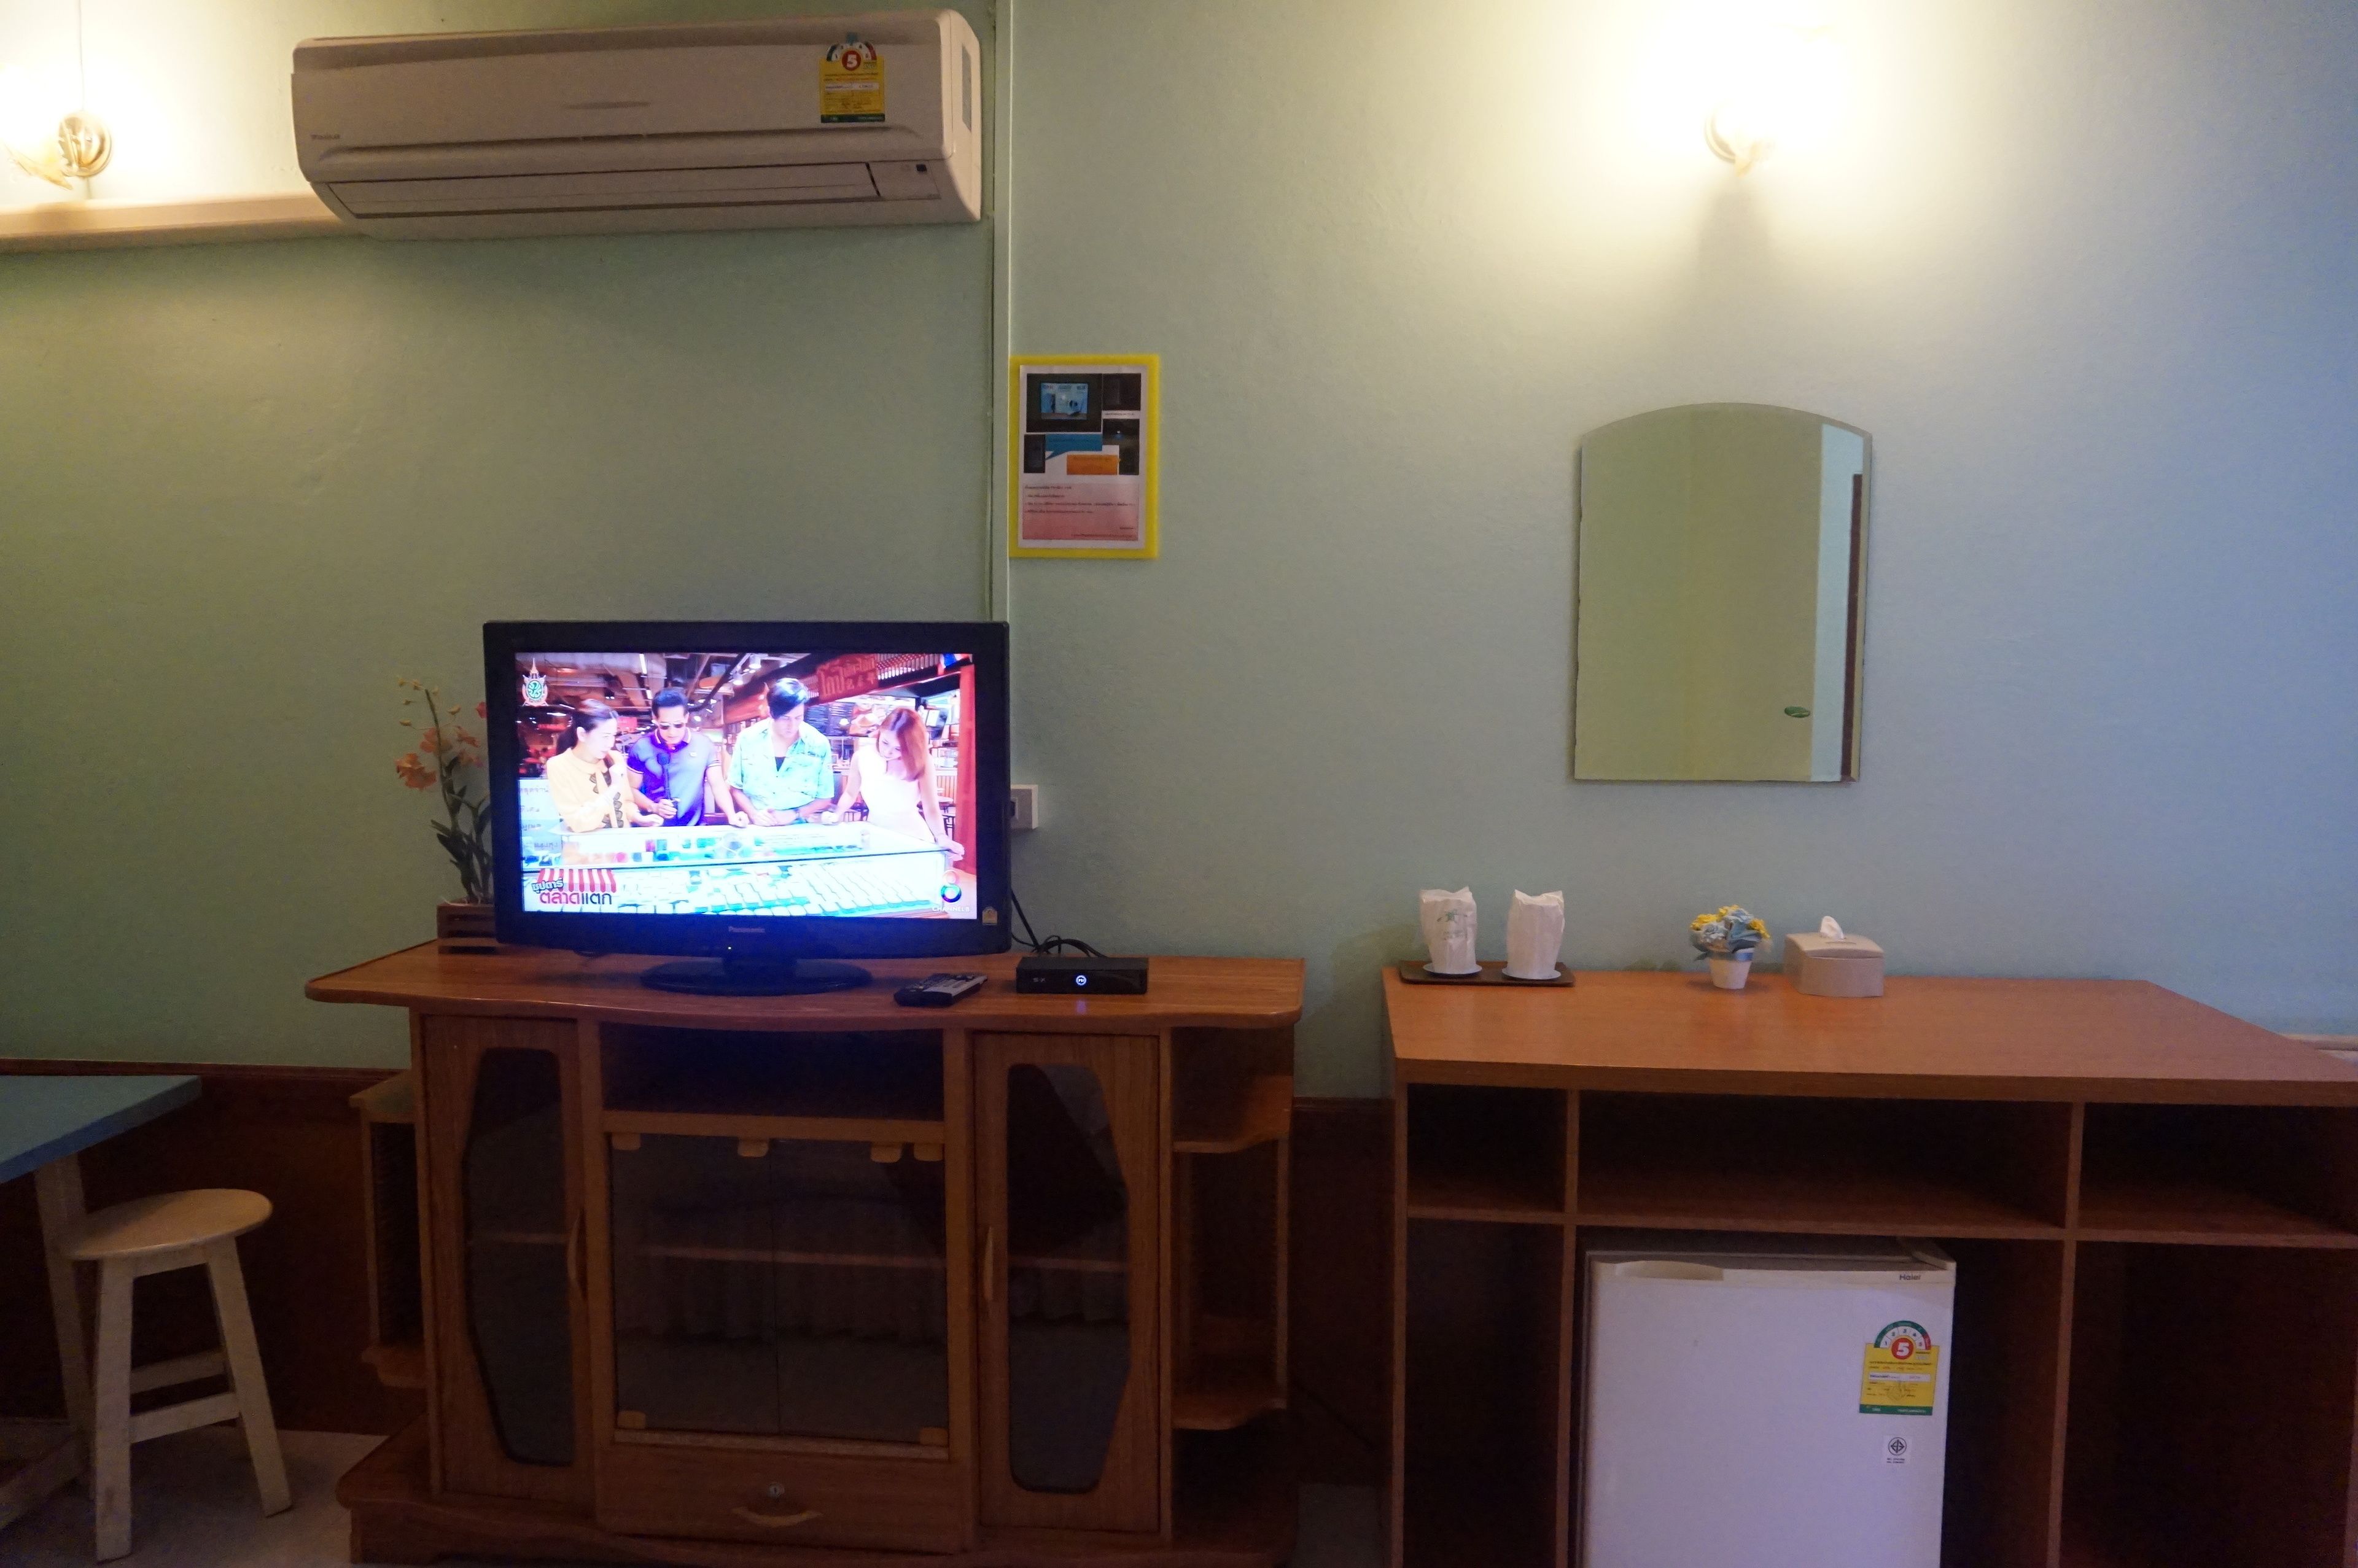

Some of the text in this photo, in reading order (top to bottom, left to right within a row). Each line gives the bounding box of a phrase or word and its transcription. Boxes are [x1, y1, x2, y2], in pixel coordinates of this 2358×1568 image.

[847, 53, 858, 68] 5
[540, 892, 612, 905] ตลาดแตก
[1896, 1342, 1910, 1357] 5
